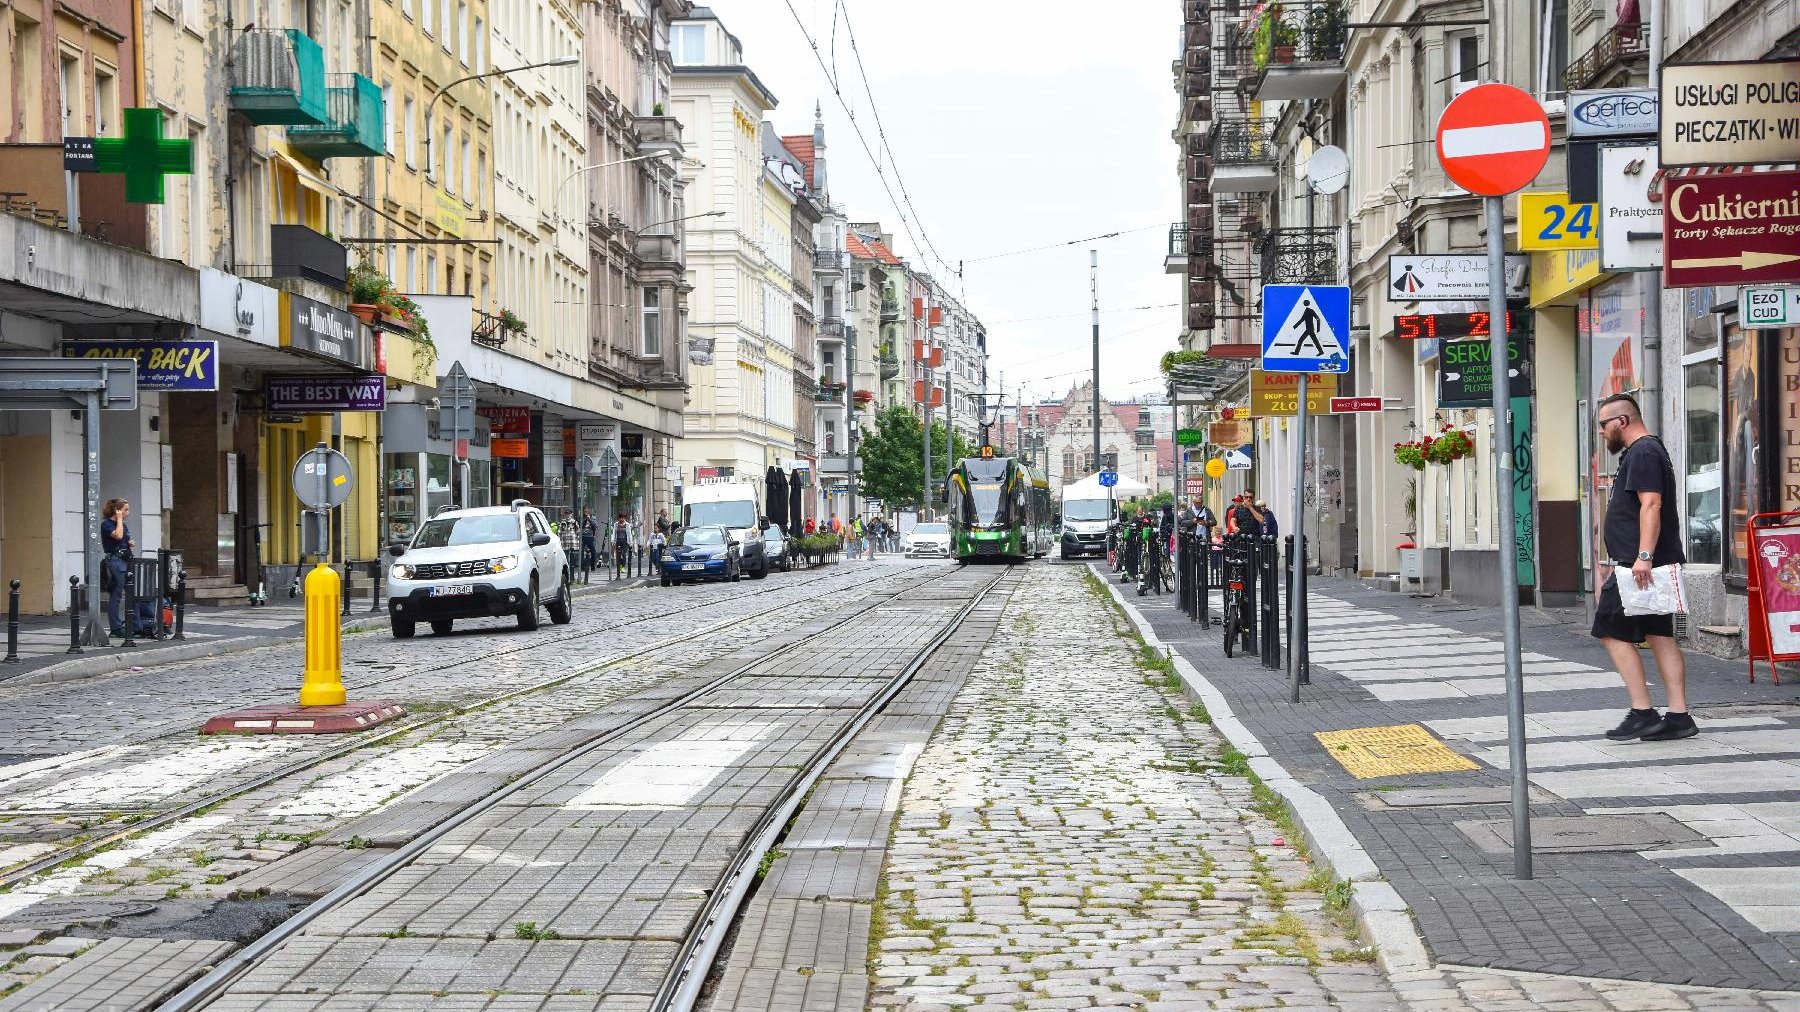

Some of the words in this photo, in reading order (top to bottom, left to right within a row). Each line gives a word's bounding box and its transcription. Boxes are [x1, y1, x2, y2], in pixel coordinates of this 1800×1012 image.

[1675, 83, 1738, 106] USŁUGI
[1746, 81, 1800, 104] POLIG
[1586, 96, 1658, 122] perfect
[1675, 119, 1765, 144] PIECZĄTKI
[1778, 118, 1800, 139] WI
[1670, 183, 1800, 223] Cukierni
[1610, 206, 1663, 218] Praktyczn
[1538, 204, 1598, 240] 24
[1674, 228, 1708, 240] Torty
[1712, 226, 1765, 239] Sękacze
[1752, 294, 1779, 305] EZO
[1753, 307, 1779, 317] CUD
[1445, 341, 1518, 364] SERWS
[147, 347, 210, 380] BACK
[270, 386, 301, 401] THE
[305, 386, 342, 401] BEST
[346, 385, 381, 400] WAY
[1271, 401, 1317, 411] ZŁOO
[1178, 431, 1200, 442] abka
[982, 446, 993, 457] 13
